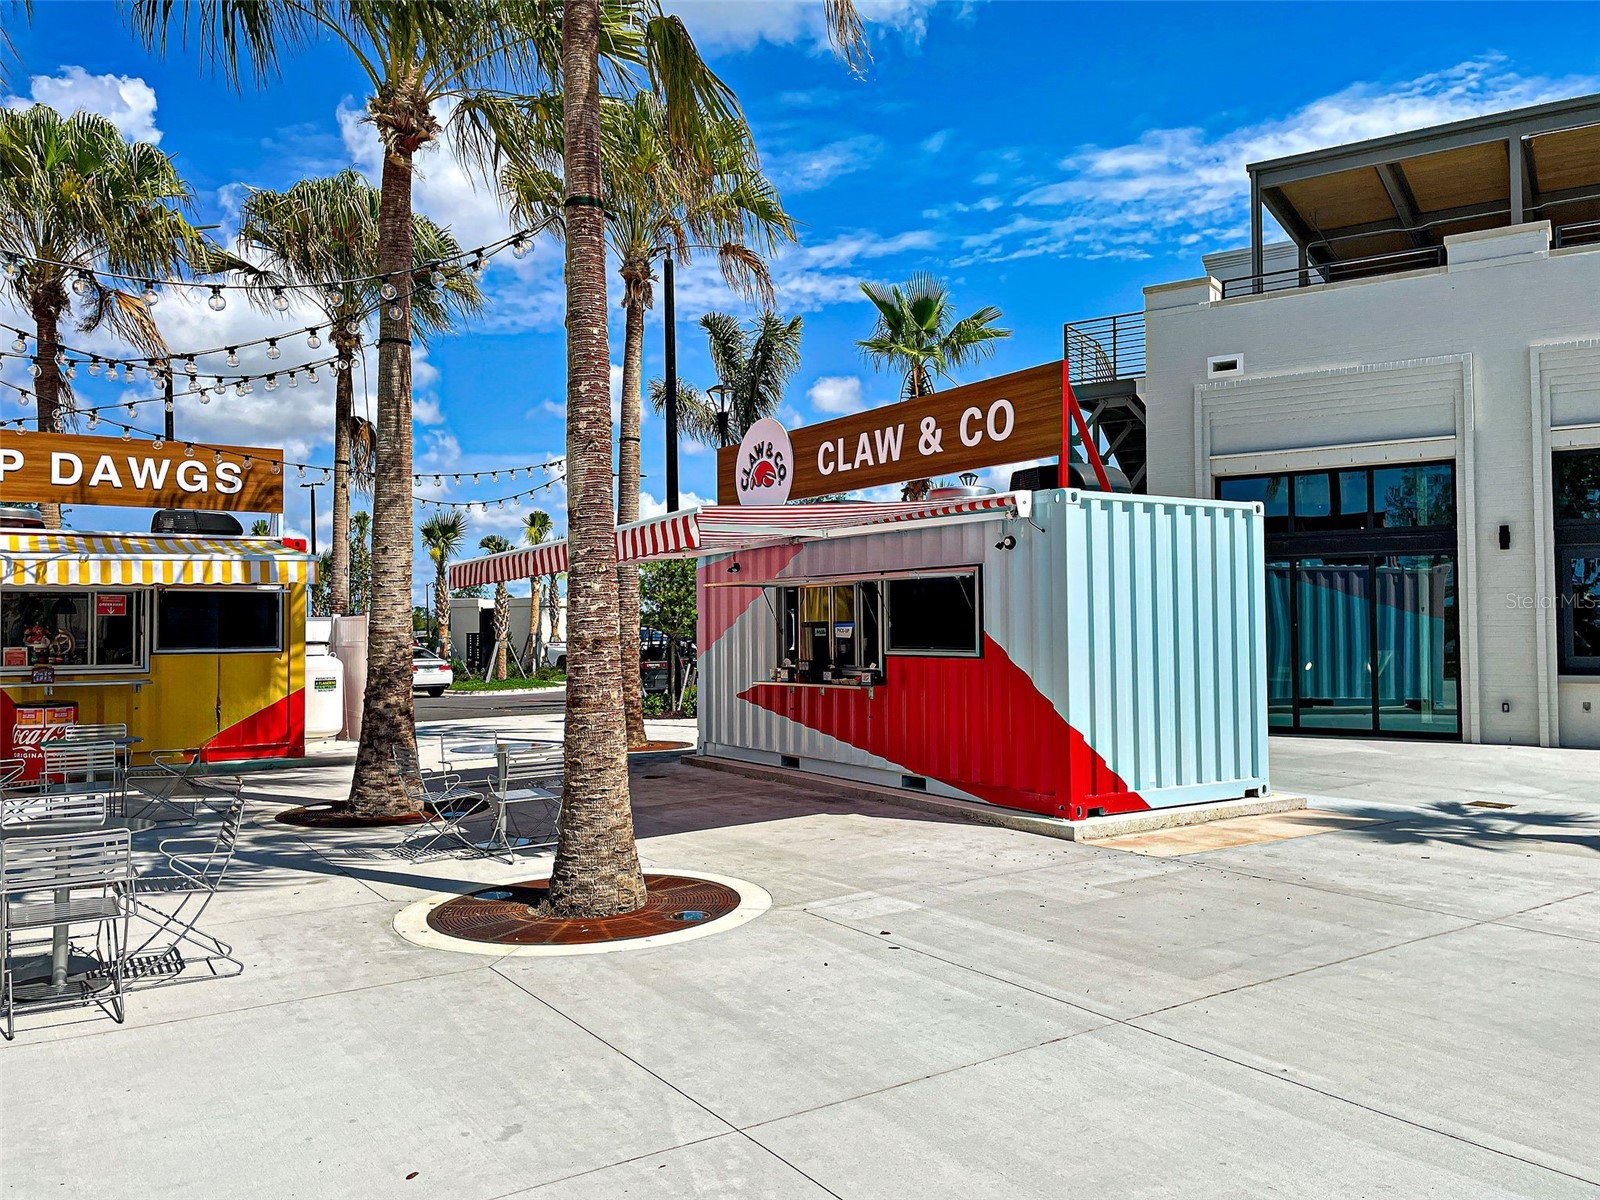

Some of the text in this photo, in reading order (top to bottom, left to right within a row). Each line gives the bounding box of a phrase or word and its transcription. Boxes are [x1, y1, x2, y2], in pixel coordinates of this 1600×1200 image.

[817, 399, 1015, 476] CLAW & CO
[51, 452, 243, 494] DAWGS
